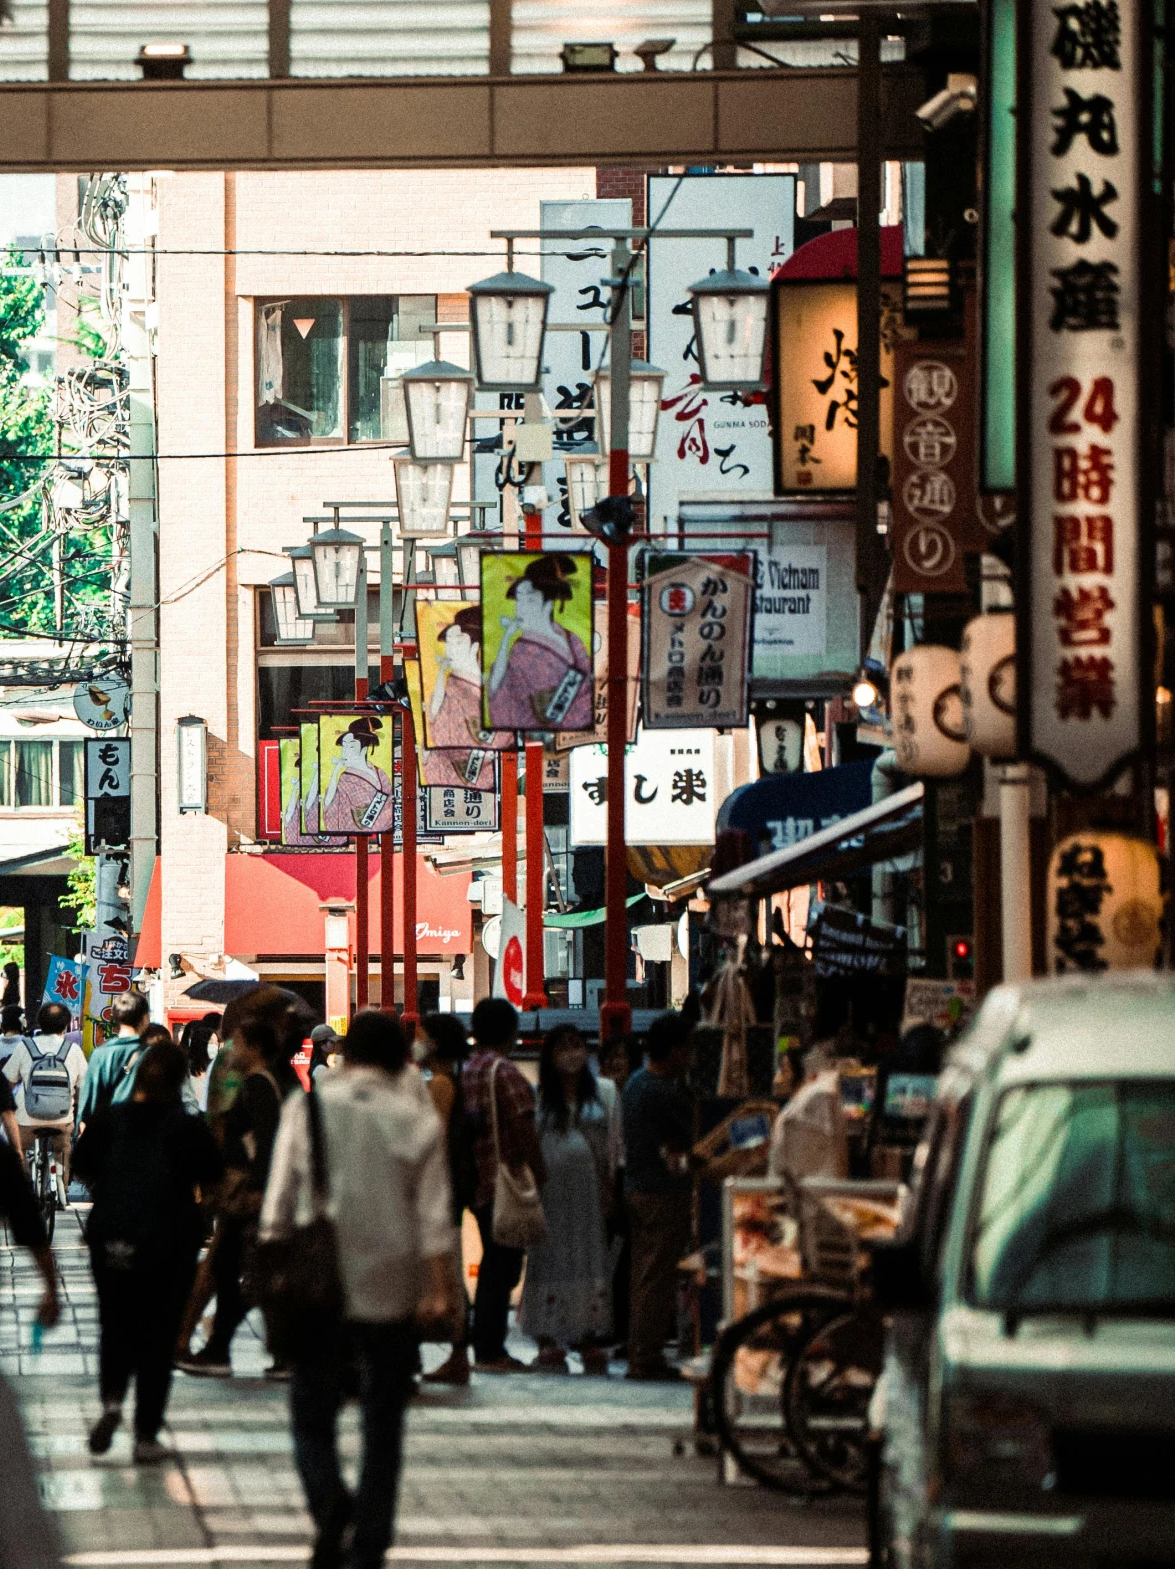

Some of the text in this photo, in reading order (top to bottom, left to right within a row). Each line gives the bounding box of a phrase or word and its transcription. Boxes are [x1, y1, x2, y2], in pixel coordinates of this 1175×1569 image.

[1050, 2, 1122, 333] 磯丸水産
[903, 360, 957, 574] 観音通り
[767, 559, 819, 591] Vietnam
[1047, 375, 1119, 722] 24時間営業
[699, 576, 729, 710] かんのん通り
[98, 743, 120, 797] もん
[434, 819, 492, 827] Kannon-dori
[415, 921, 462, 944] Omiya
[54, 970, 80, 1000] 氷
